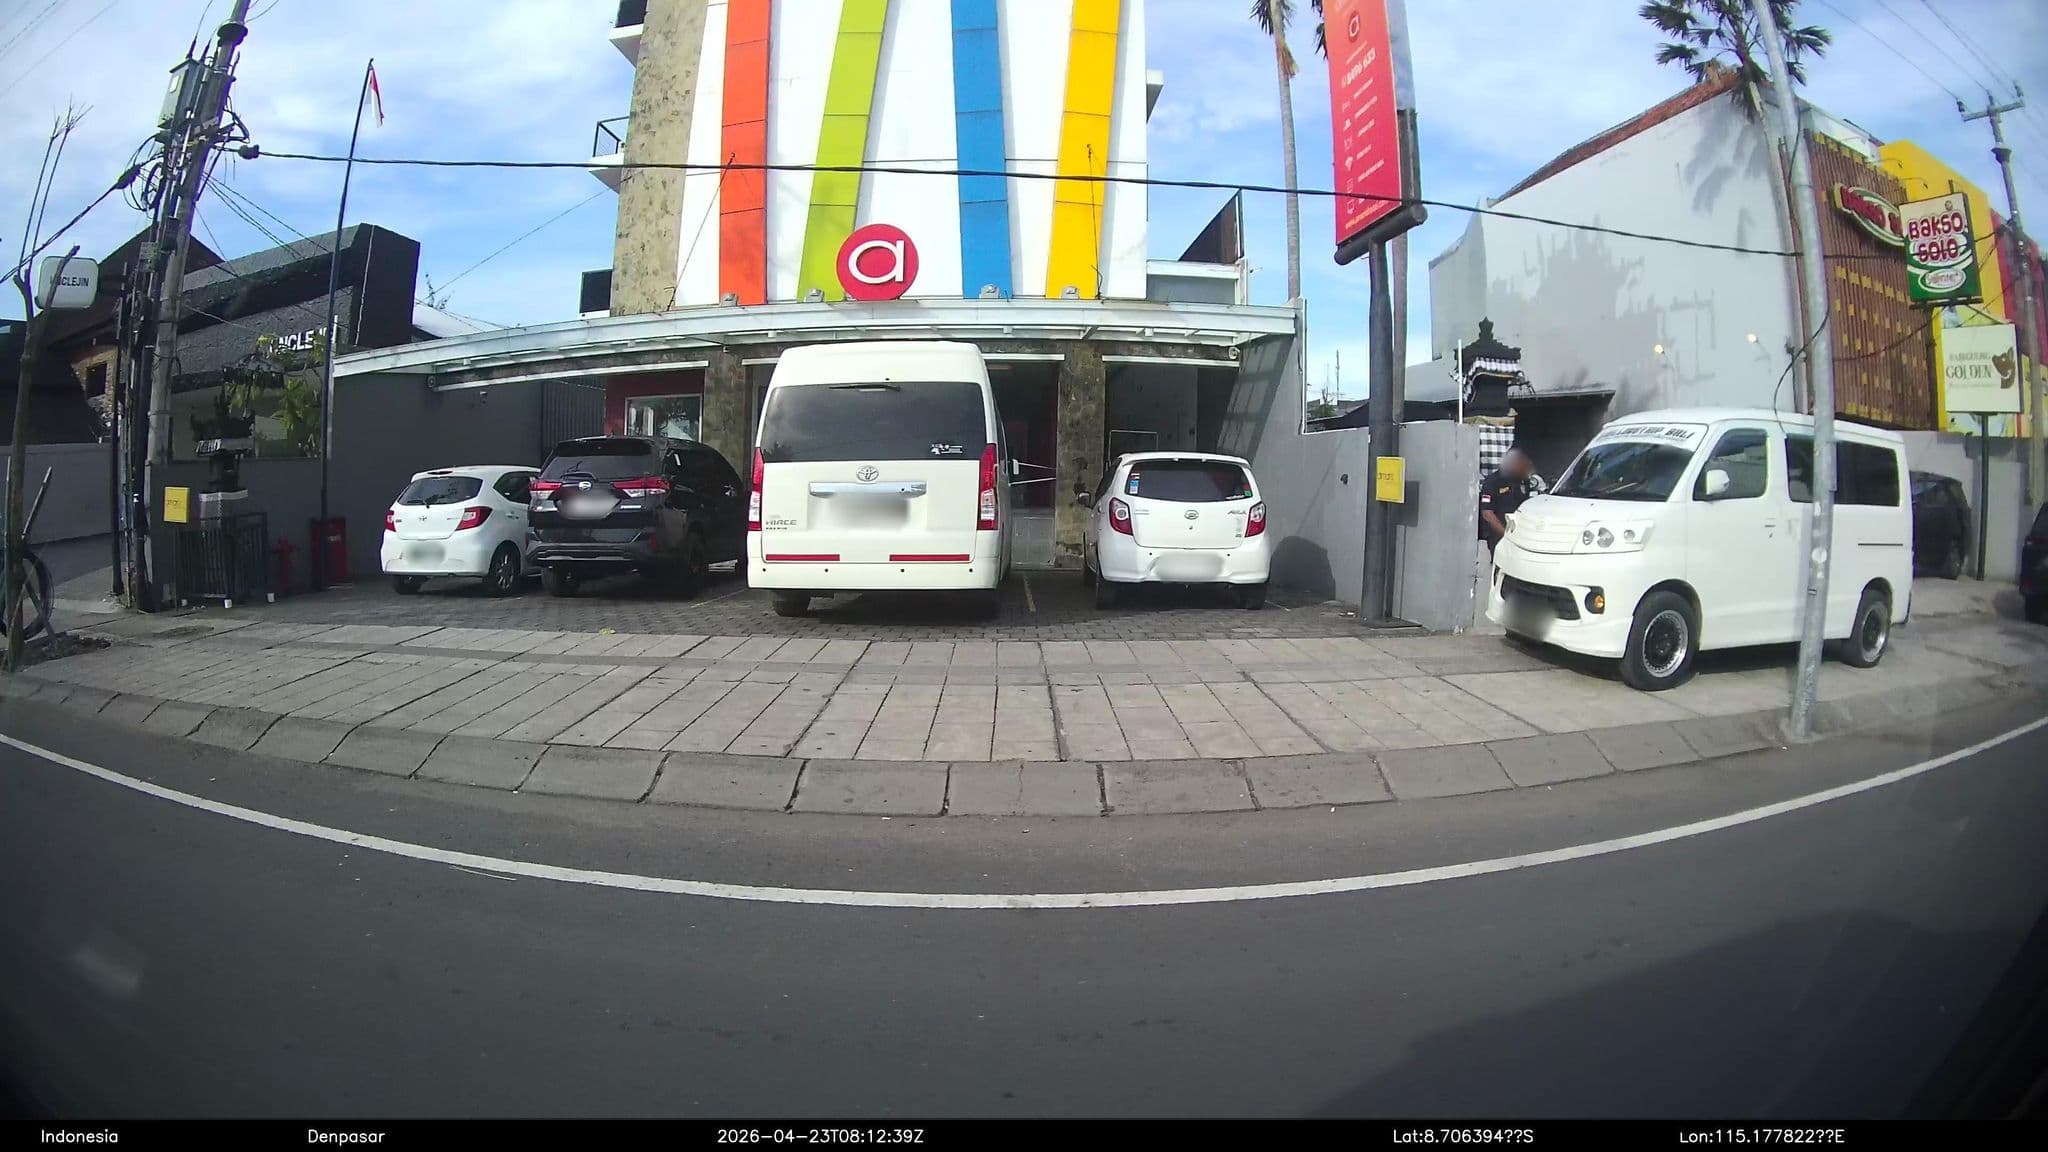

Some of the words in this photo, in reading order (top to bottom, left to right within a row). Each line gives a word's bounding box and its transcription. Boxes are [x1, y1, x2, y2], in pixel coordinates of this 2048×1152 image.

[848, 239, 904, 285] a
[50, 275, 89, 287] CLEJIN
[1946, 364, 1992, 379] GOLDEN
